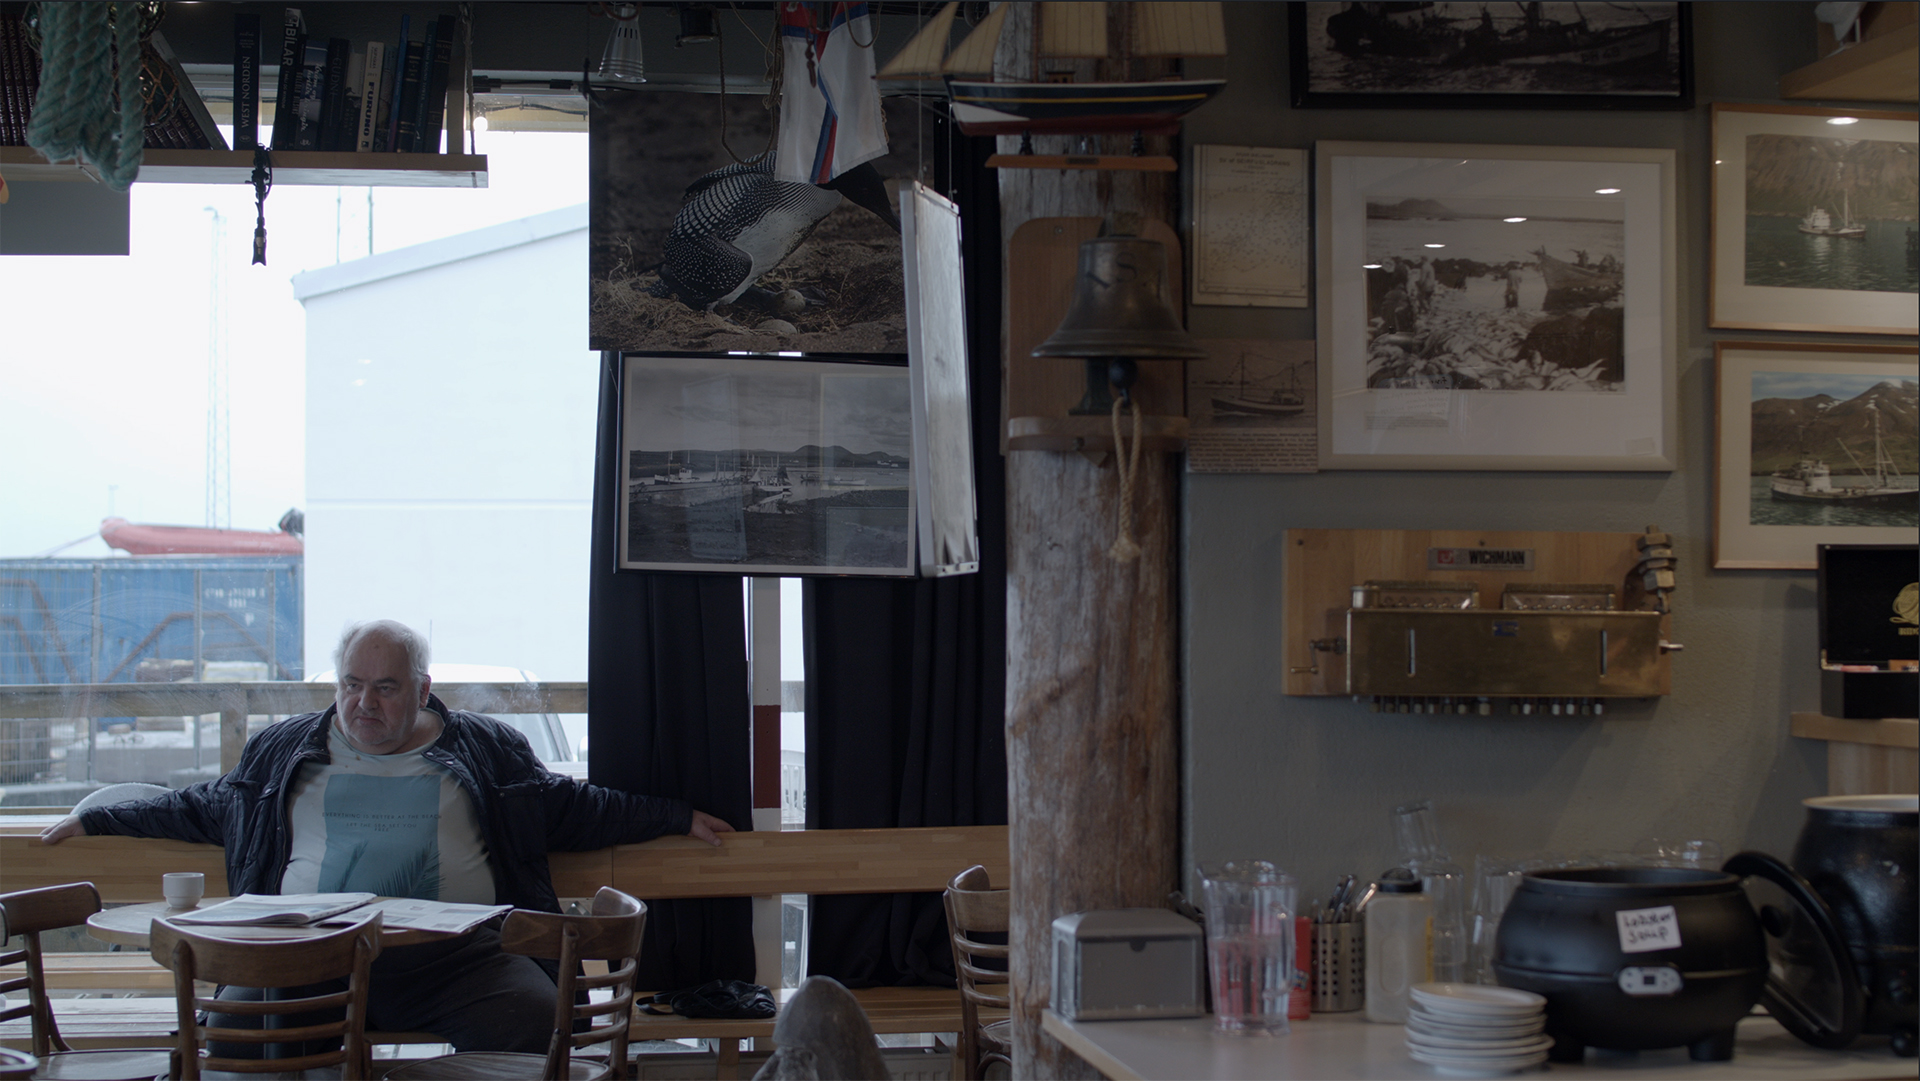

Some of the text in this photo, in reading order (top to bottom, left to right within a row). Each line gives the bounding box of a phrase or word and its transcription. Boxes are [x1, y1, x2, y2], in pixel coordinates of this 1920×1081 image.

[282, 27, 298, 66] BÍLAR
[241, 56, 251, 100] NORDEN
[240, 101, 250, 128] WEST
[364, 82, 375, 136] FURUNO
[1468, 550, 1525, 564] WICHMANN
